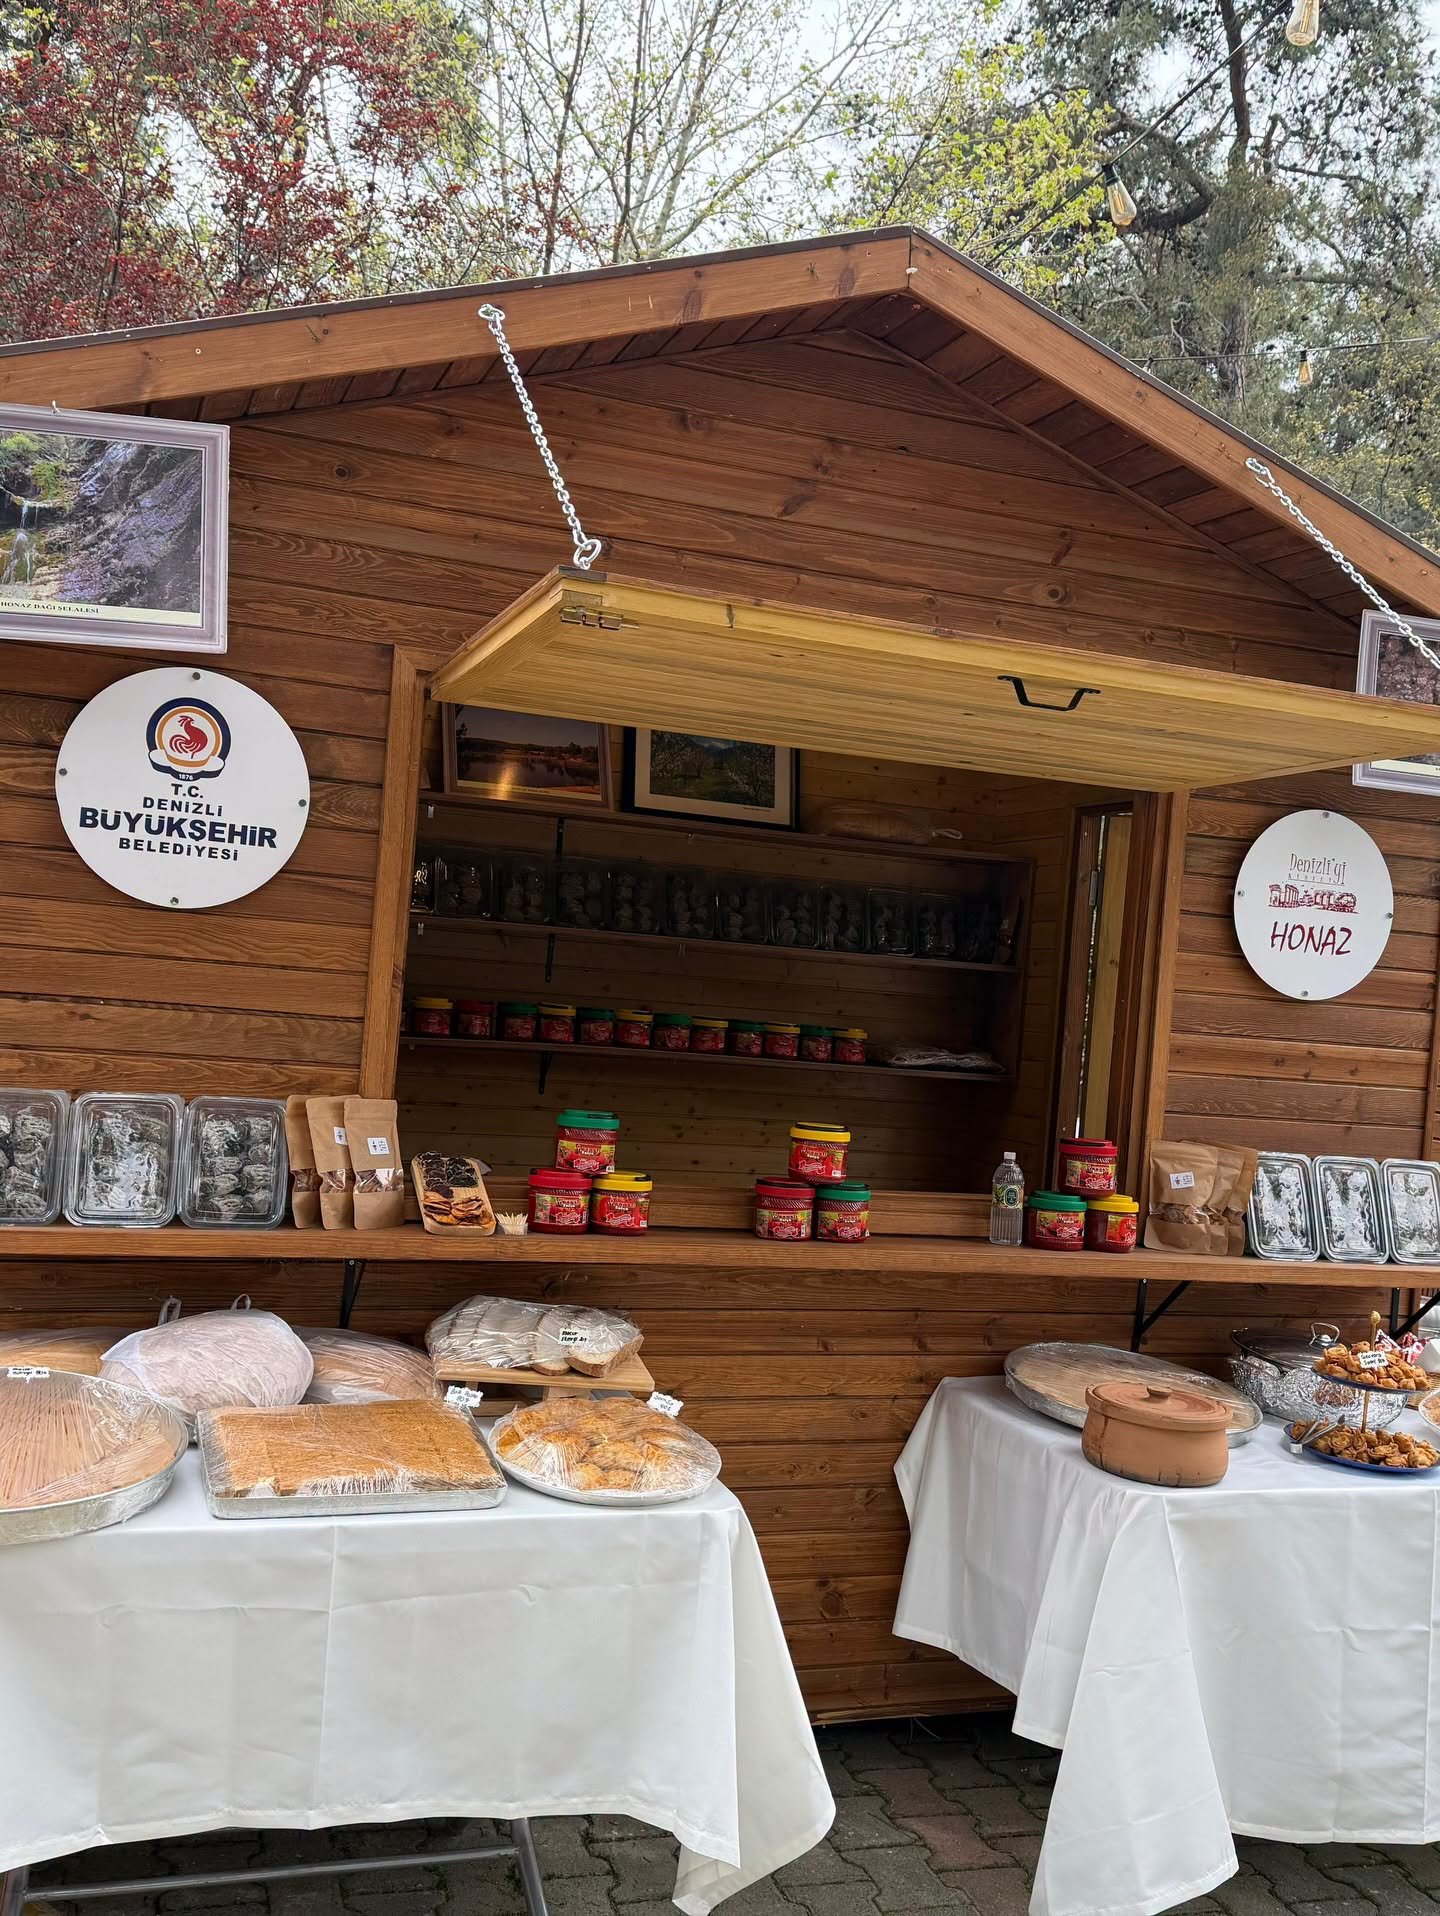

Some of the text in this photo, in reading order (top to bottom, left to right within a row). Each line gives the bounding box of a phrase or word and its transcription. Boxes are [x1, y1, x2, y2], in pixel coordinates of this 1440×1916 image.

[178, 773, 194, 781] 1876
[171, 783, 204, 799] T.C.
[142, 797, 223, 817] DENİZLİ
[79, 806, 278, 849] BÜYÜKŞEHİR
[118, 837, 239, 861] BELEDİYESİ
[1270, 921, 1353, 956] HONAZ
